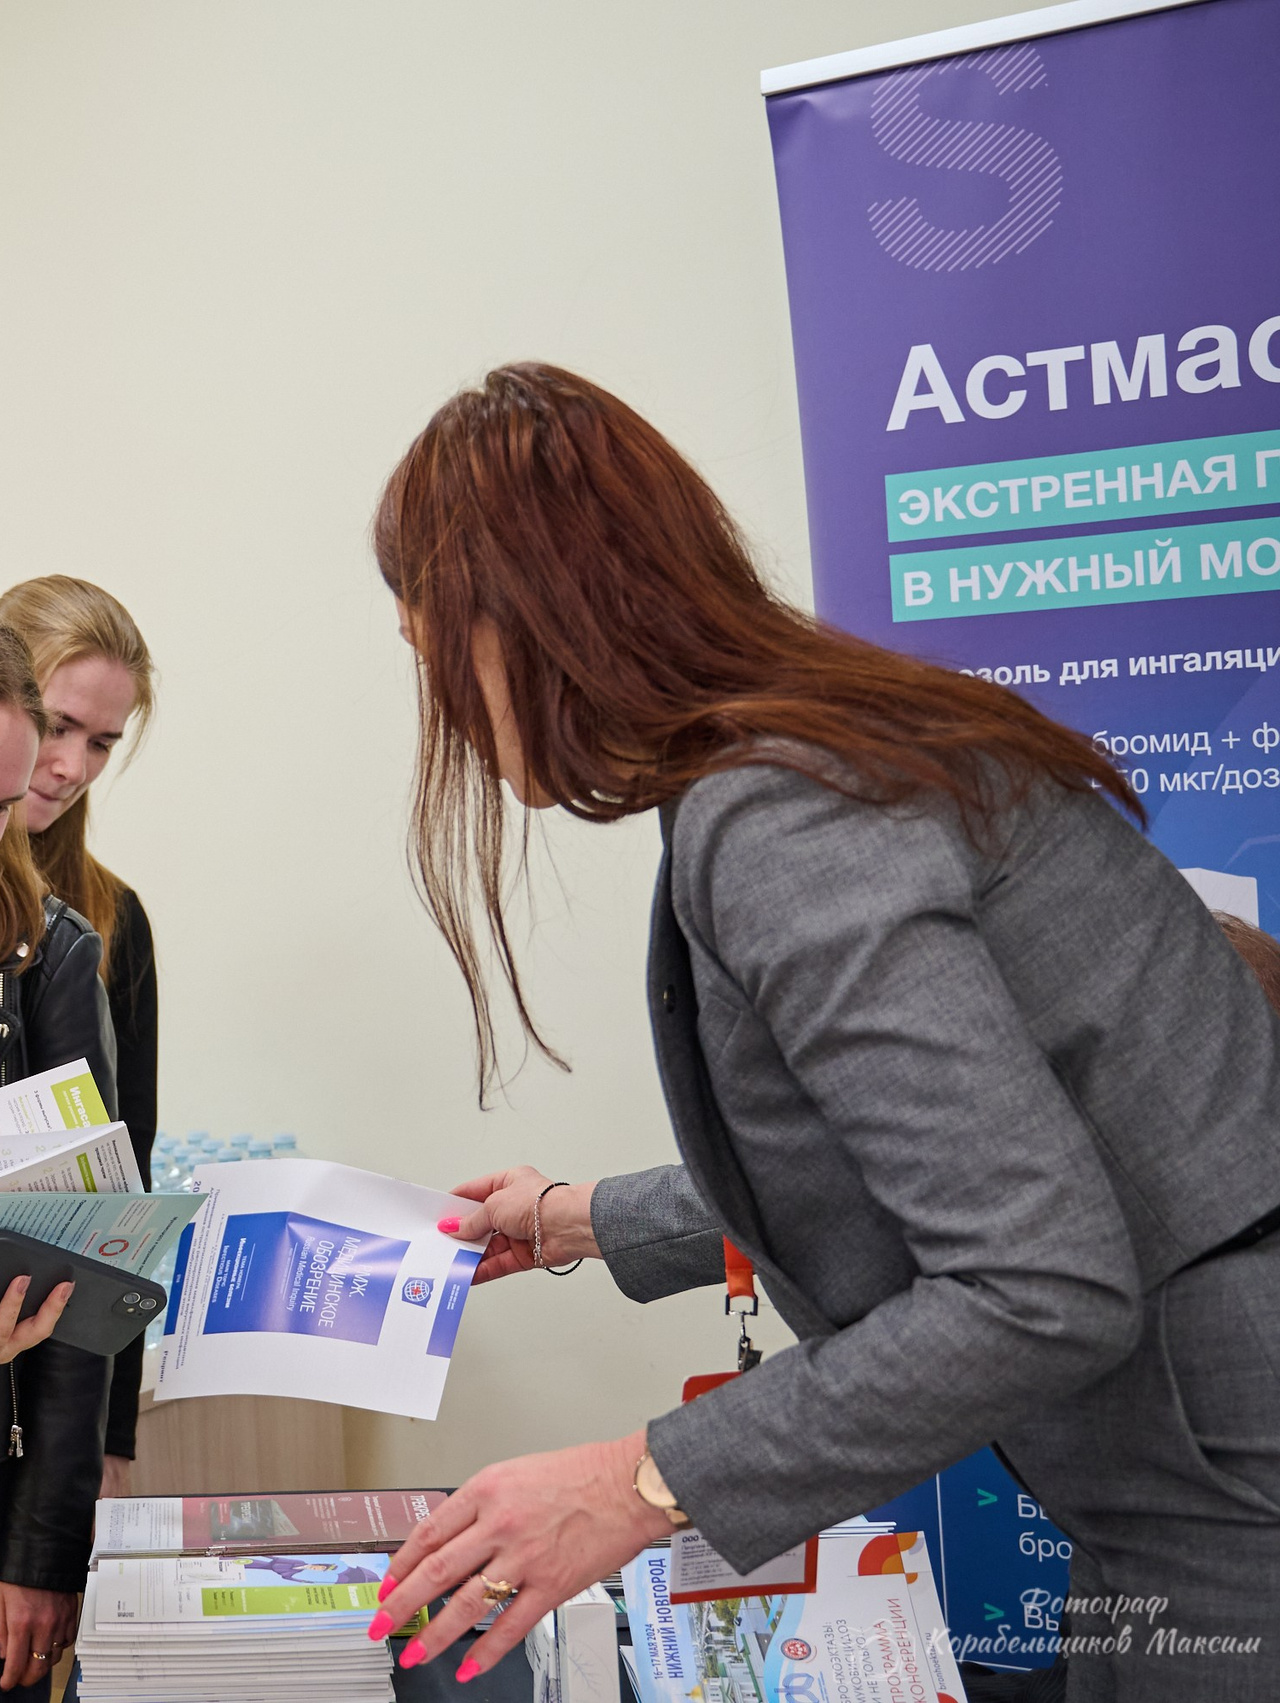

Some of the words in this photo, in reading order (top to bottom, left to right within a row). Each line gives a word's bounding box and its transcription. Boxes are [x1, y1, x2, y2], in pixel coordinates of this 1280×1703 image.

[898, 454, 1237, 525] ЭКСТРЕННАЯ
[904, 571, 934, 607] В
[949, 537, 1182, 603] НУЖНЫЙ
[1059, 659, 1119, 686] для
[293, 1260, 307, 1287] Medical
[300, 1236, 315, 1260] Russian
[286, 1287, 300, 1311] Inquiry
[299, 1240, 335, 1313] ОБОЗРЕНИЕ
[318, 1236, 362, 1328] МЕДИЦИНСКОЕ
[648, 1558, 675, 1623] НОВГОРОД
[645, 1623, 657, 1641] 2024
[648, 1641, 660, 1658] МАЯ
[657, 1627, 684, 1679] НИЖНИЙ
[887, 1598, 927, 1703] КОНФЕРЕНЦИИ
[867, 1680, 881, 1694] НЕ
[873, 1620, 905, 1703] ПРОГРАММА
